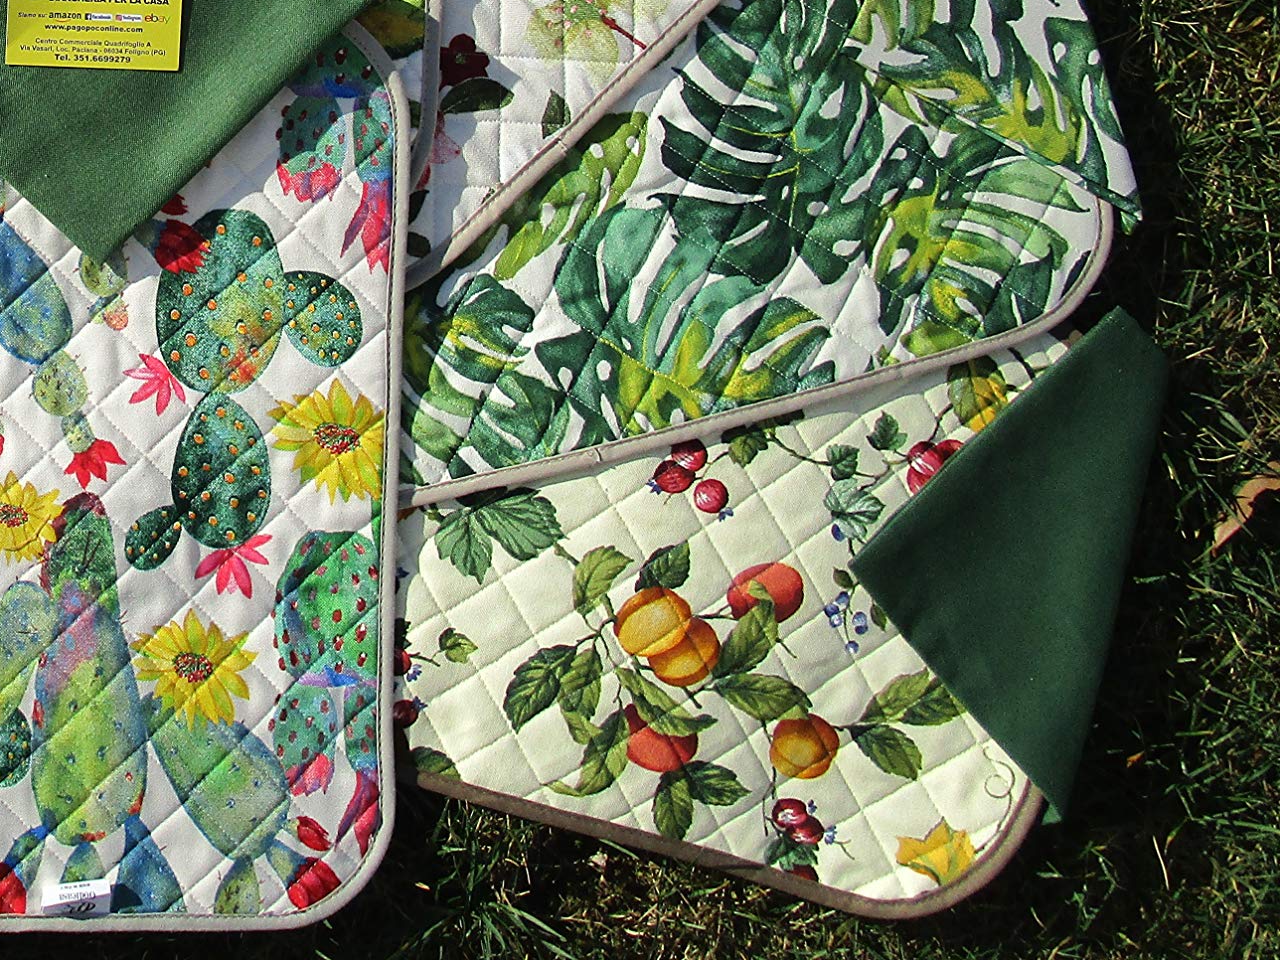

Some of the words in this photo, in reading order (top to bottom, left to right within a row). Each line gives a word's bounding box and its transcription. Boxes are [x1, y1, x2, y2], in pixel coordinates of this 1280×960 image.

[144, 13, 171, 24] ebay
[104, 40, 145, 48] Quadrifoglio
[151, 49, 166, 57] (PG)
[73, 54, 131, 63] 351.6699279
